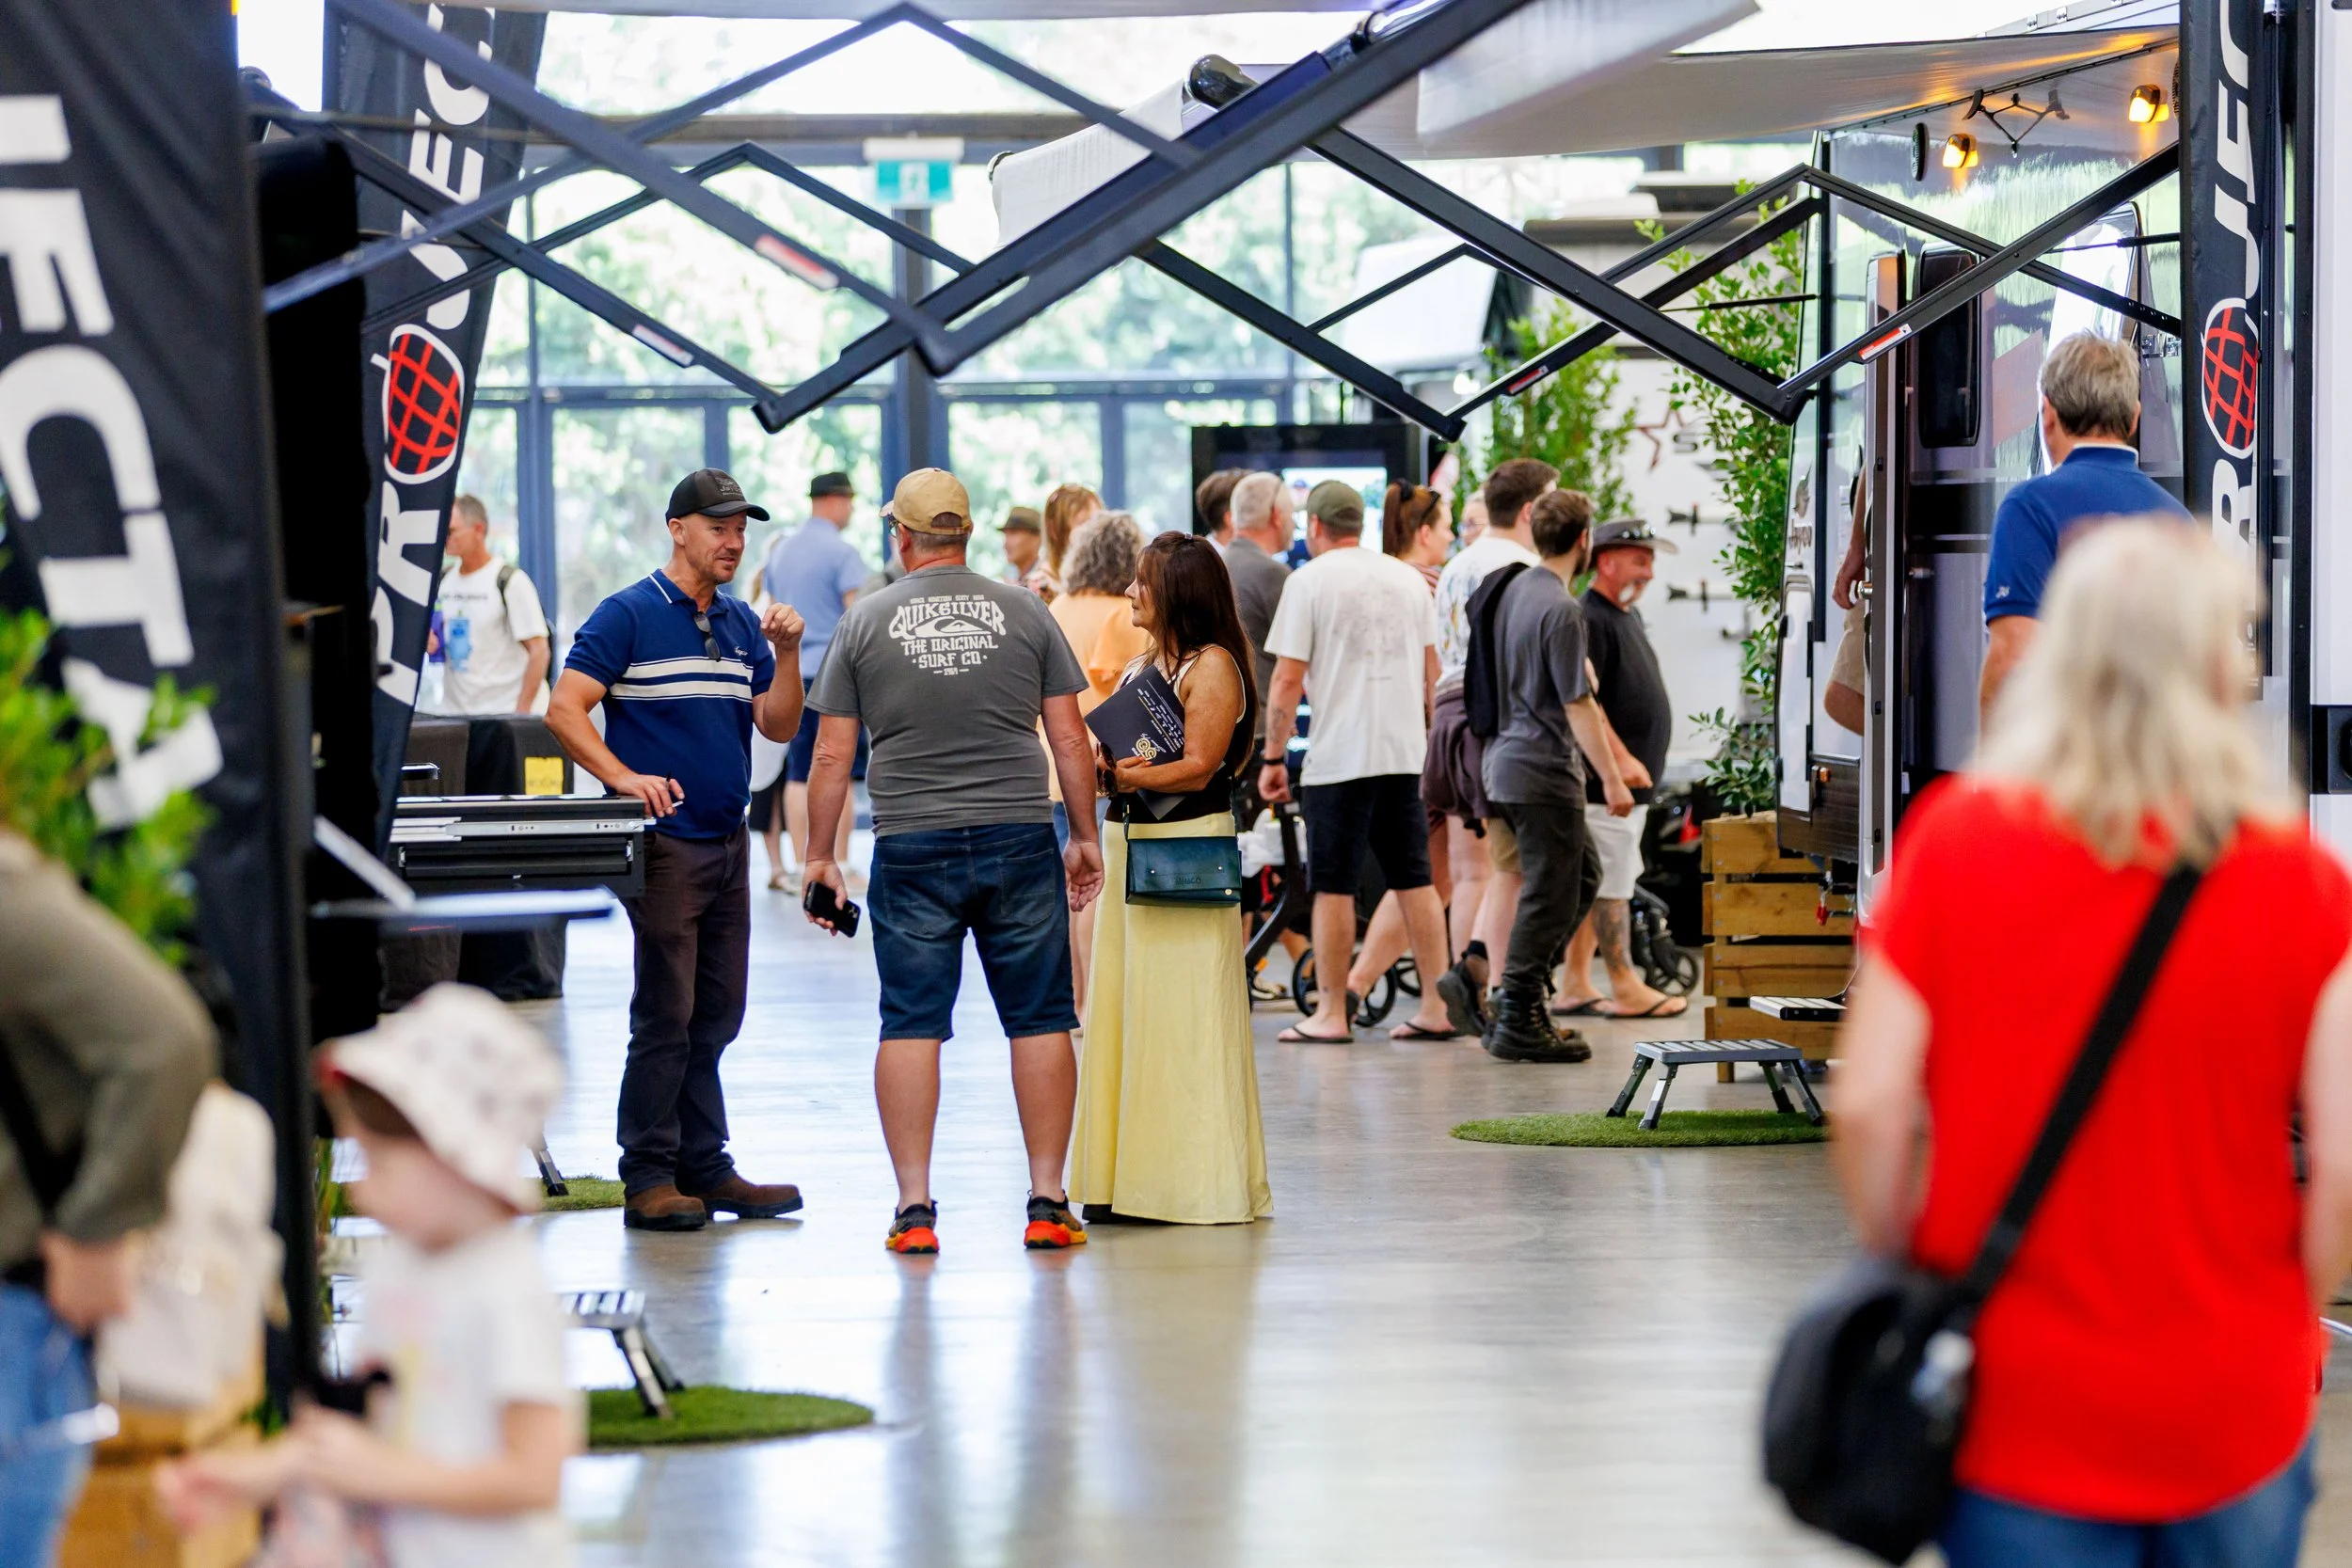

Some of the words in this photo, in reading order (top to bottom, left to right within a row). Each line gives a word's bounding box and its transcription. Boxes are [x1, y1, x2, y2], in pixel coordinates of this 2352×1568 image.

[369, 3, 495, 706] PROJEC
[888, 600, 1007, 640] QUIKSILVER
[900, 639, 928, 656] THE
[930, 635, 999, 652] ORIGINAL
[918, 653, 957, 669] SURF
